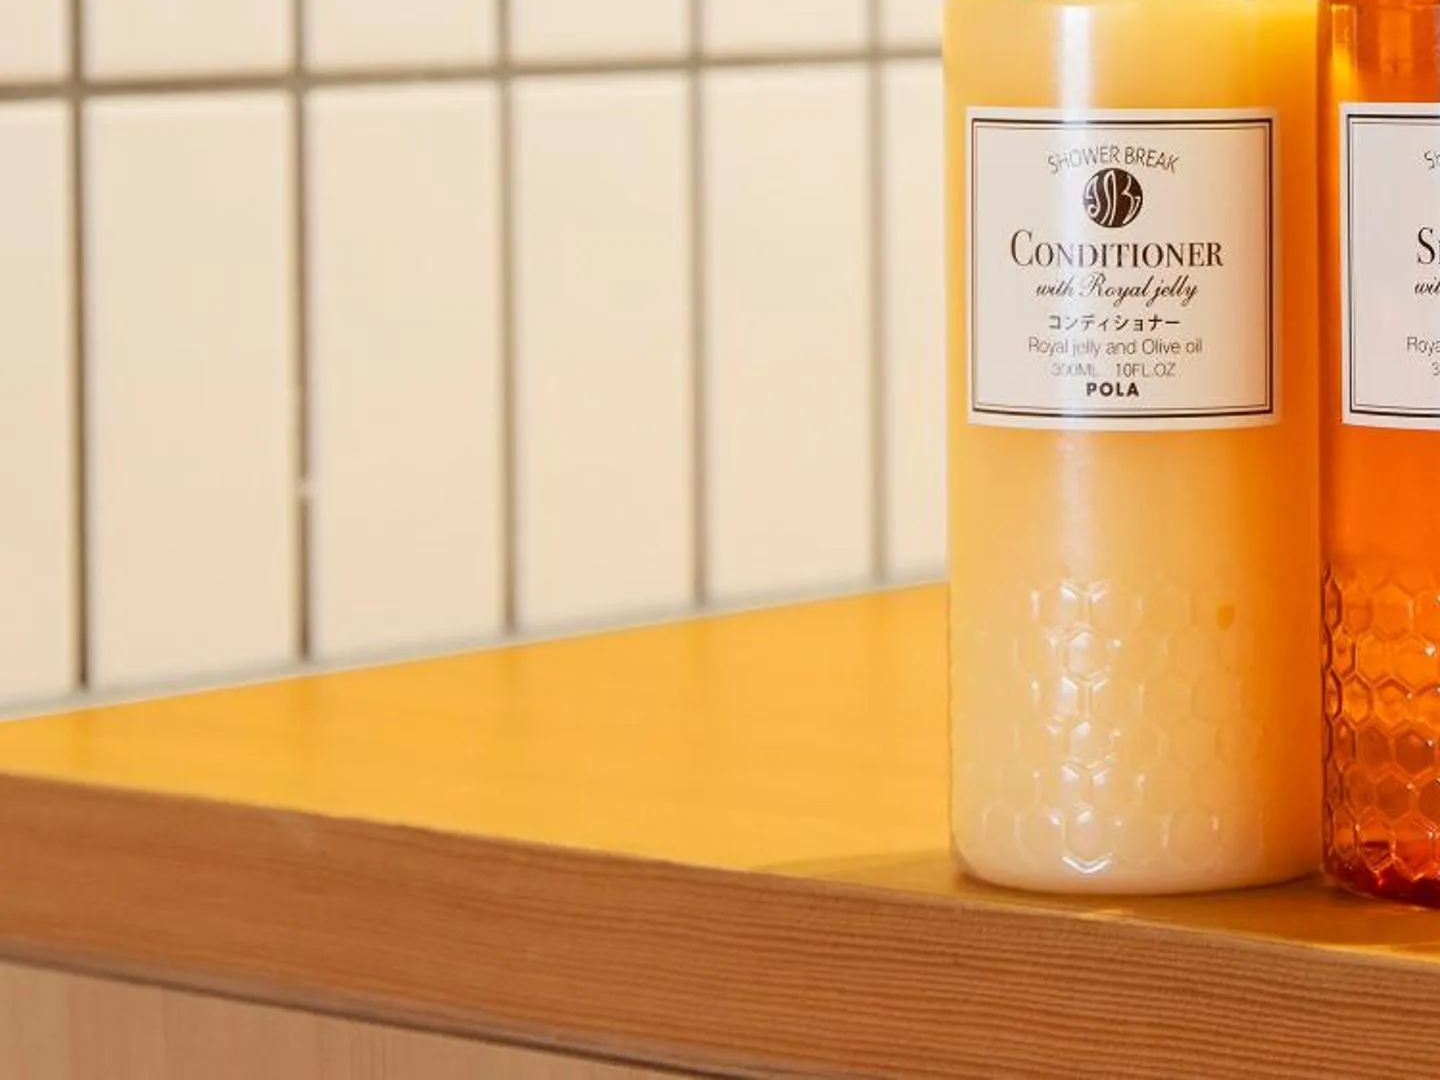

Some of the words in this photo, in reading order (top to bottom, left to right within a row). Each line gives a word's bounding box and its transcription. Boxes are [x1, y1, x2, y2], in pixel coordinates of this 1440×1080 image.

[1047, 146, 1120, 174] SHOWER
[1125, 147, 1180, 172] BREAK
[1036, 274, 1076, 297] with
[1079, 272, 1151, 307] Royal
[1145, 274, 1199, 307] jelly
[1048, 314, 1180, 331] コンディショナー
[1028, 337, 1068, 356] Royal
[1072, 338, 1100, 356] jelly
[1106, 338, 1136, 354] and
[1141, 338, 1180, 354] Olive
[1186, 338, 1203, 354] oil
[1086, 382, 1139, 397] POLA
